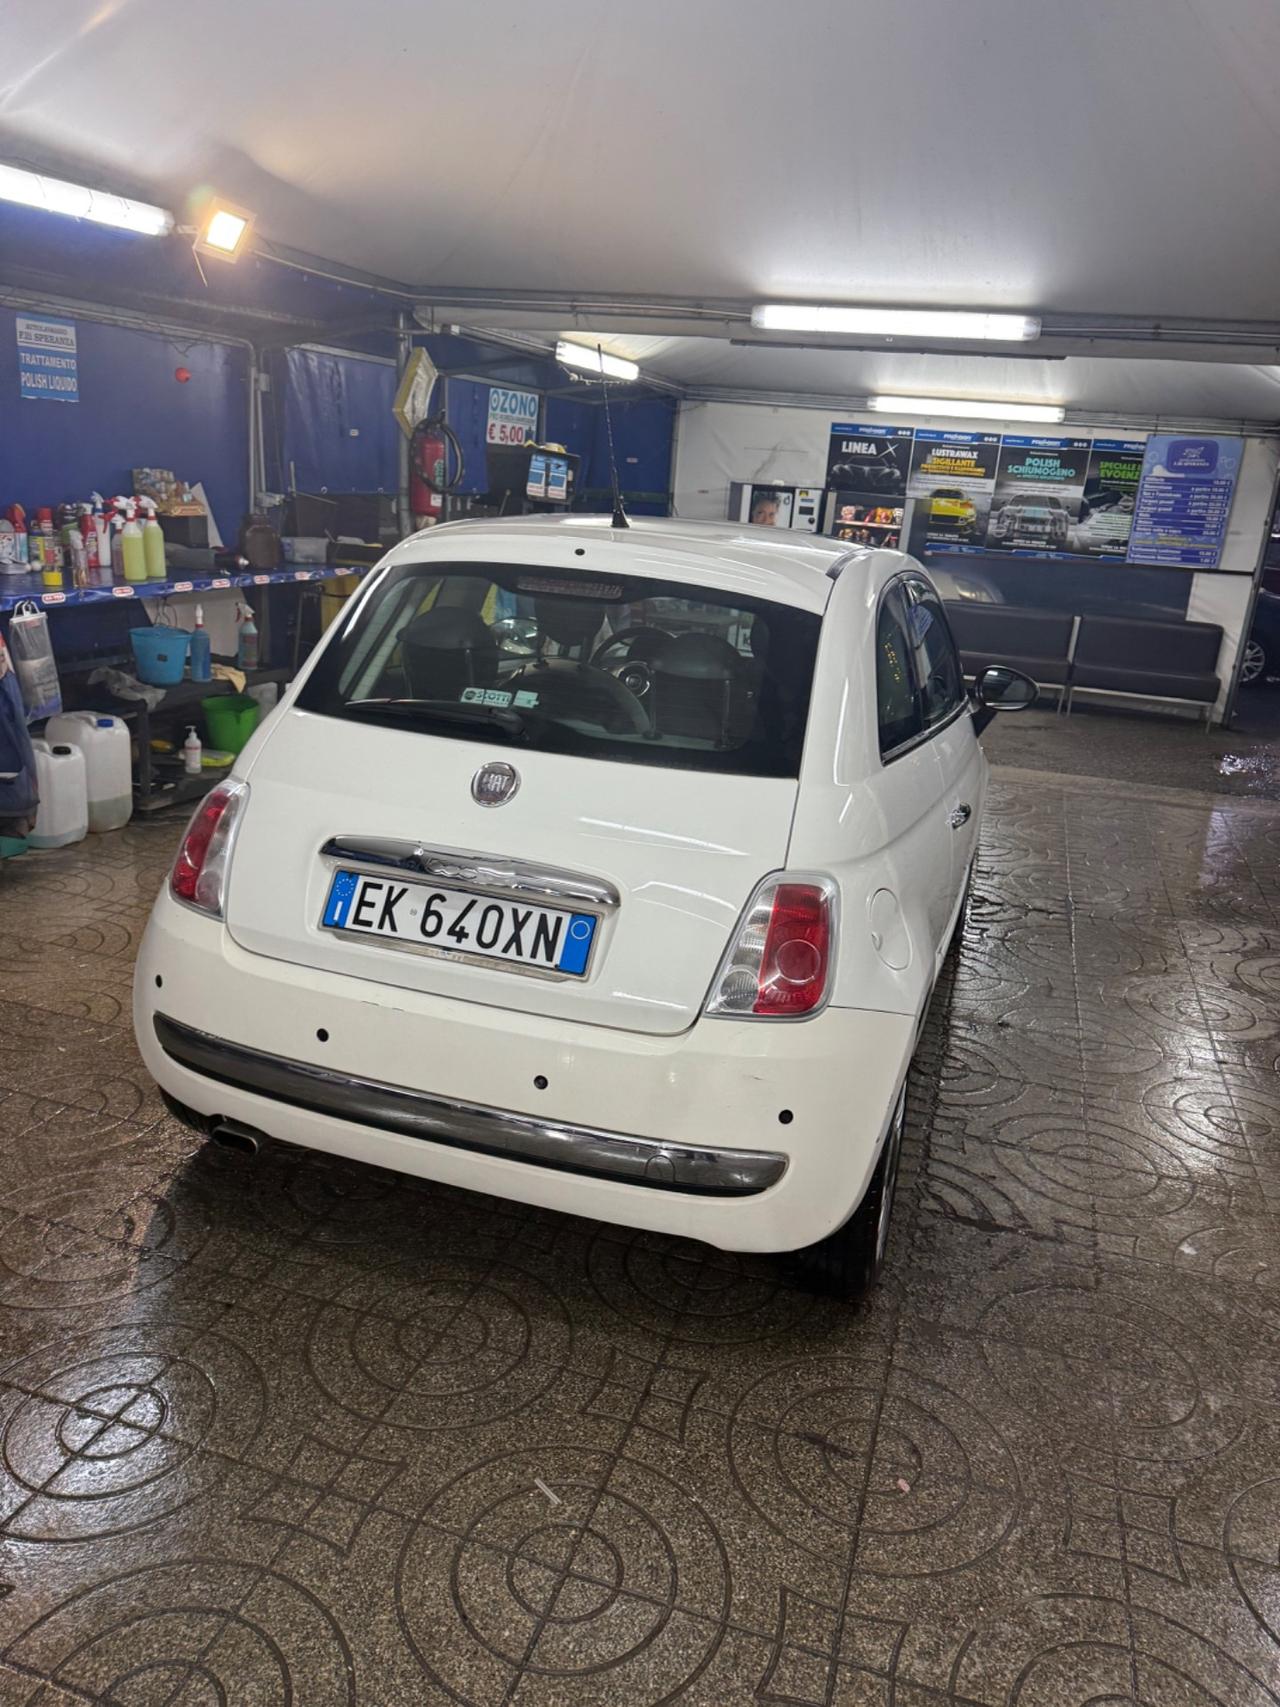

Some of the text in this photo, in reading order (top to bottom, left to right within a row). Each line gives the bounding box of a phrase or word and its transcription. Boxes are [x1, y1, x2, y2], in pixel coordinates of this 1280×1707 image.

[20, 352, 77, 370] TRATTAMENTO
[21, 372, 77, 392] POLISH LIQUIDO
[490, 390, 537, 417] OZONO
[488, 423, 524, 443] € 5,00
[841, 441, 877, 455] LINEA
[931, 448, 979, 460] LUSTRAWAX
[1025, 457, 1061, 468] POLISH
[1100, 461, 1136, 471] SPECIALE
[1007, 464, 1076, 478] SCHIUMOGENO
[352, 881, 563, 963] EK 640XN
